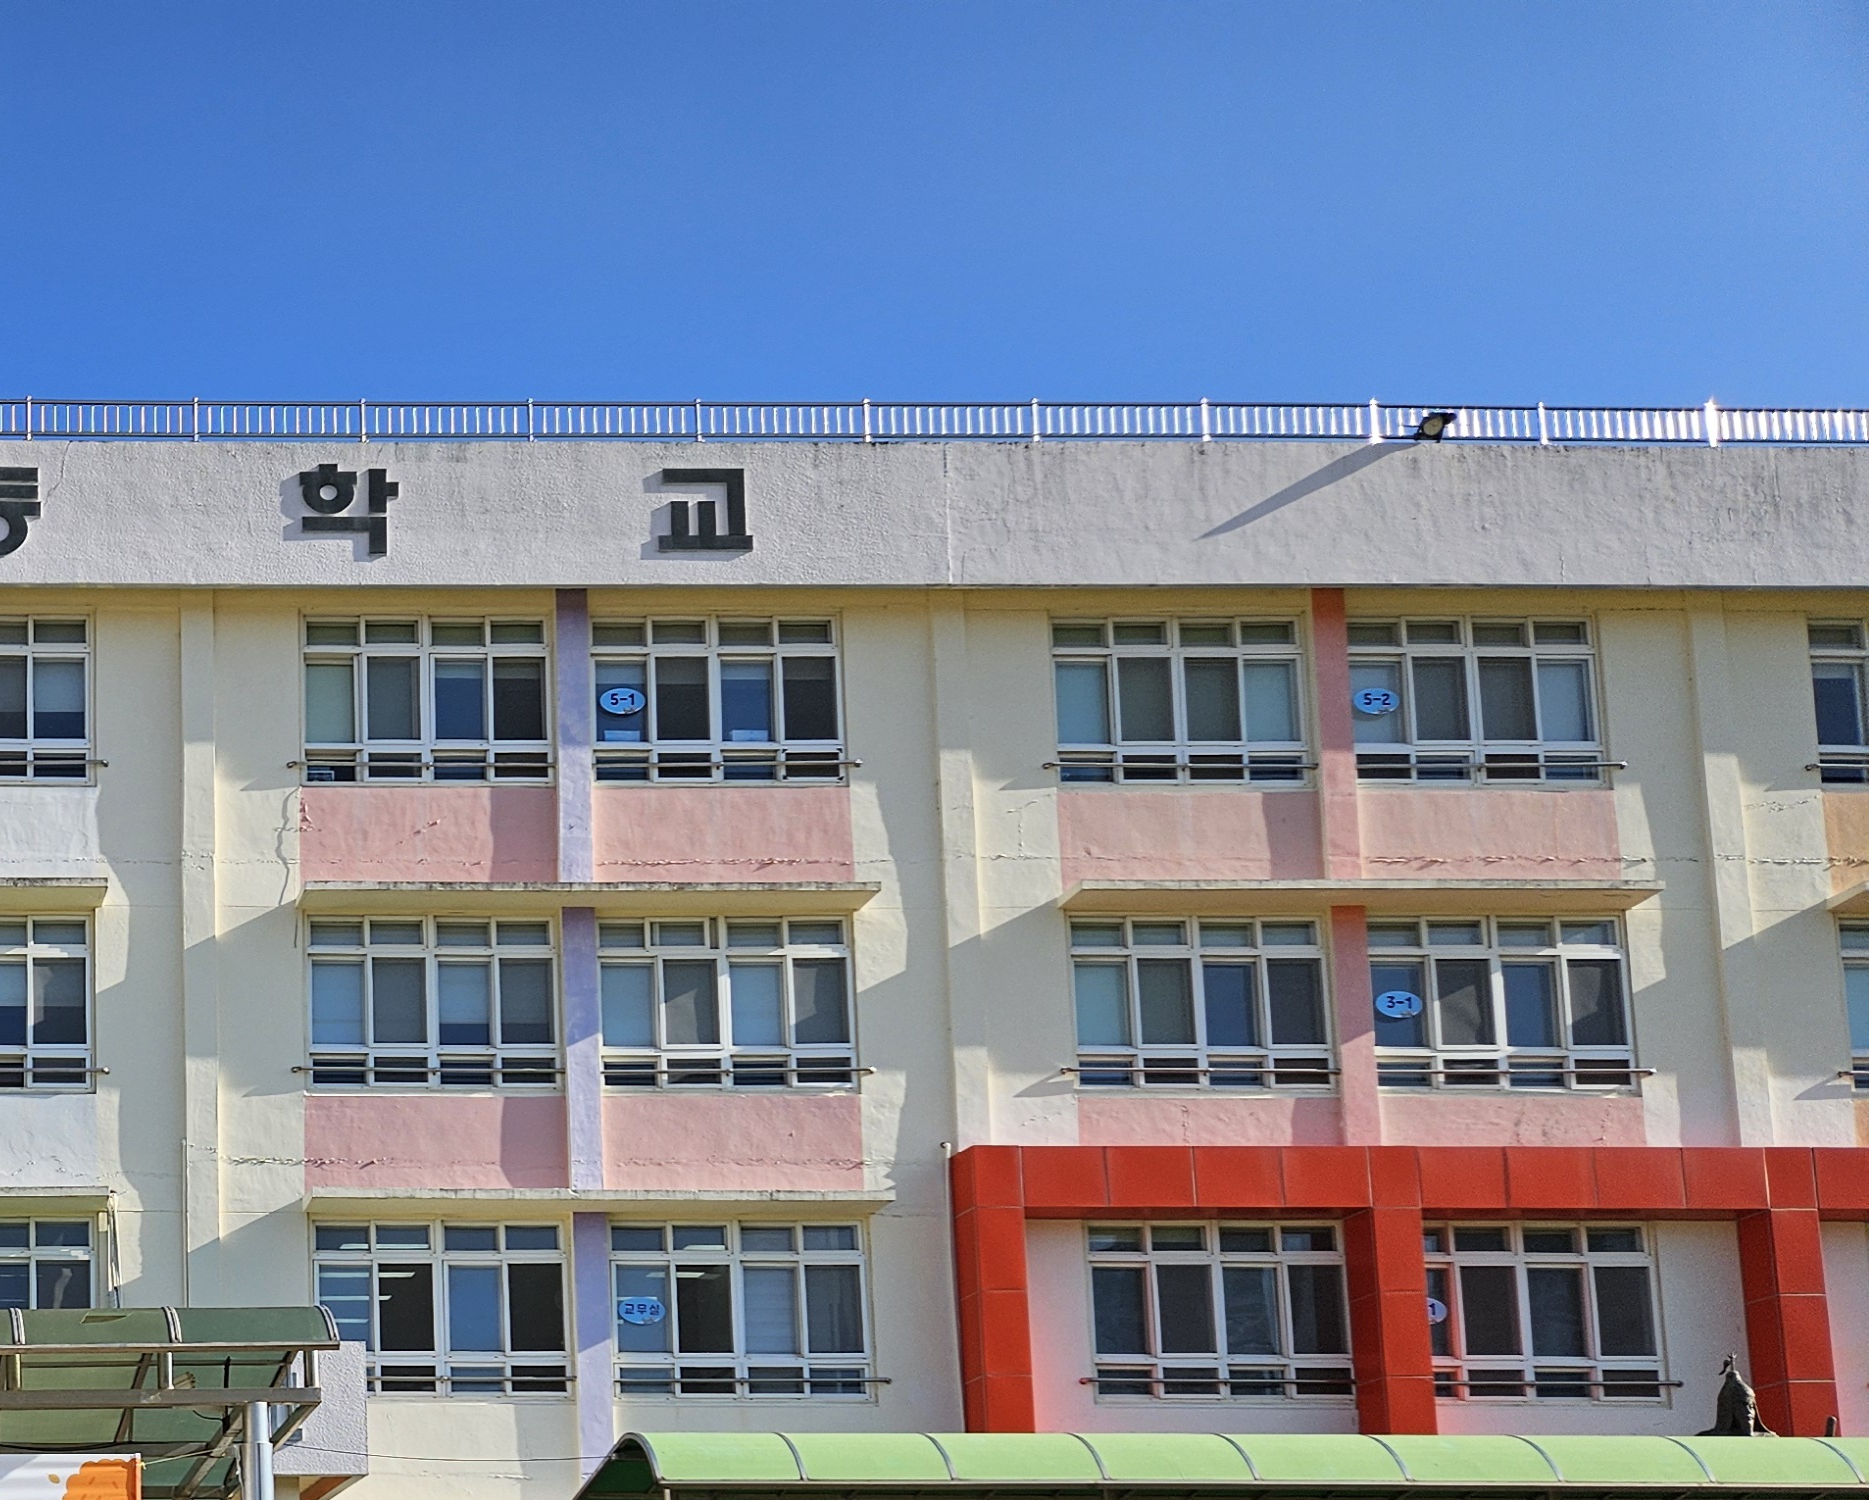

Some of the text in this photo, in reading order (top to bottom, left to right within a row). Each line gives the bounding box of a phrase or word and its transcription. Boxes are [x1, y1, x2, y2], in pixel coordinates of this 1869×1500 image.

[610, 693, 635, 705] 5-1
[1364, 693, 1390, 706] 5-2
[1386, 996, 1412, 1009] 3-1
[624, 1303, 660, 1316] 교무실
